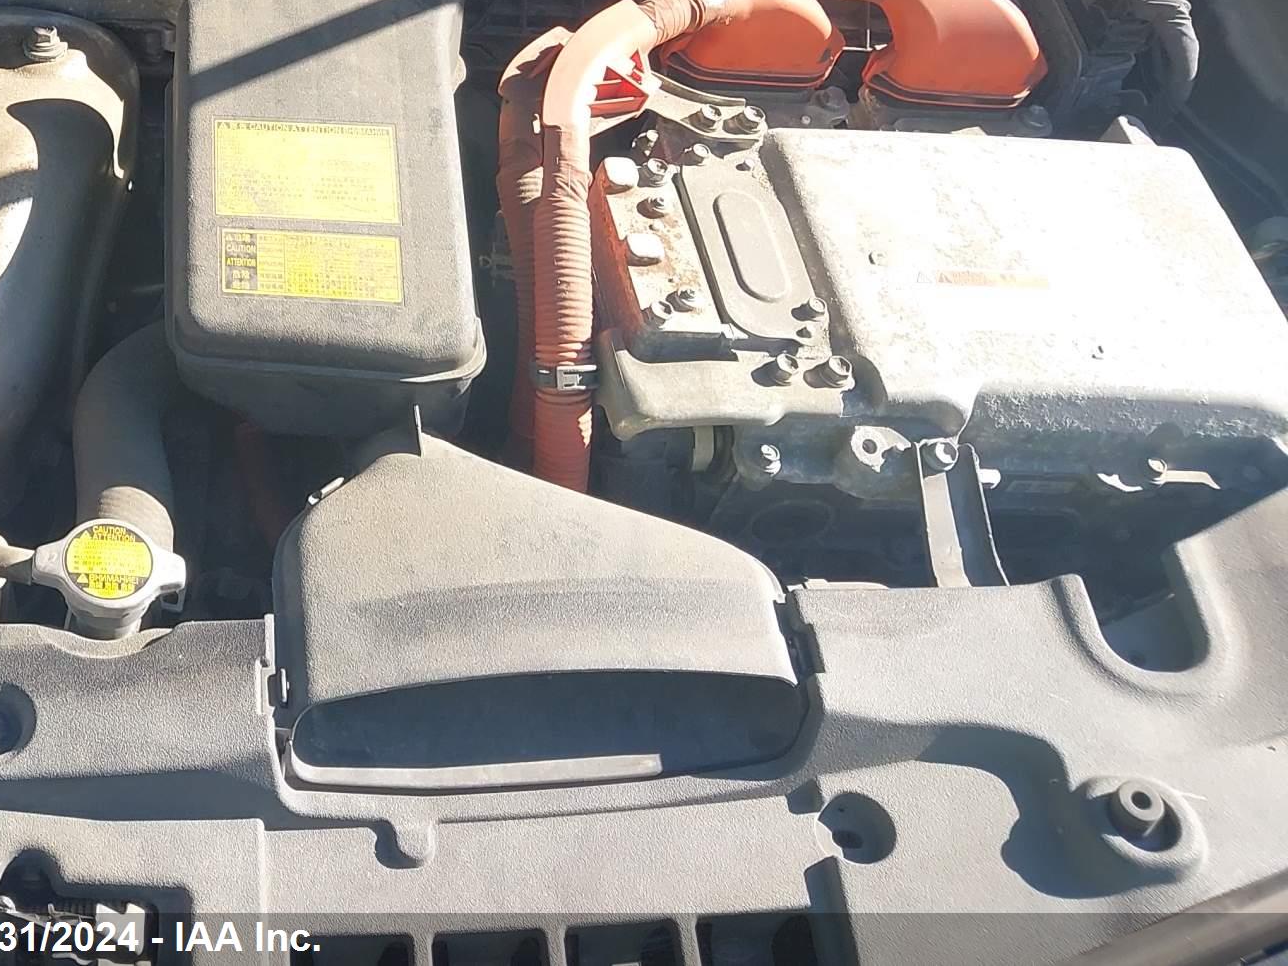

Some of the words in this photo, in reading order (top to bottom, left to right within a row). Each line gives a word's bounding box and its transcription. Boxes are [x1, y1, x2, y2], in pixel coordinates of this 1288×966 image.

[226, 244, 256, 253] CAUTION
[92, 526, 127, 535] CAUTION
[93, 533, 136, 543] ATTENTION
